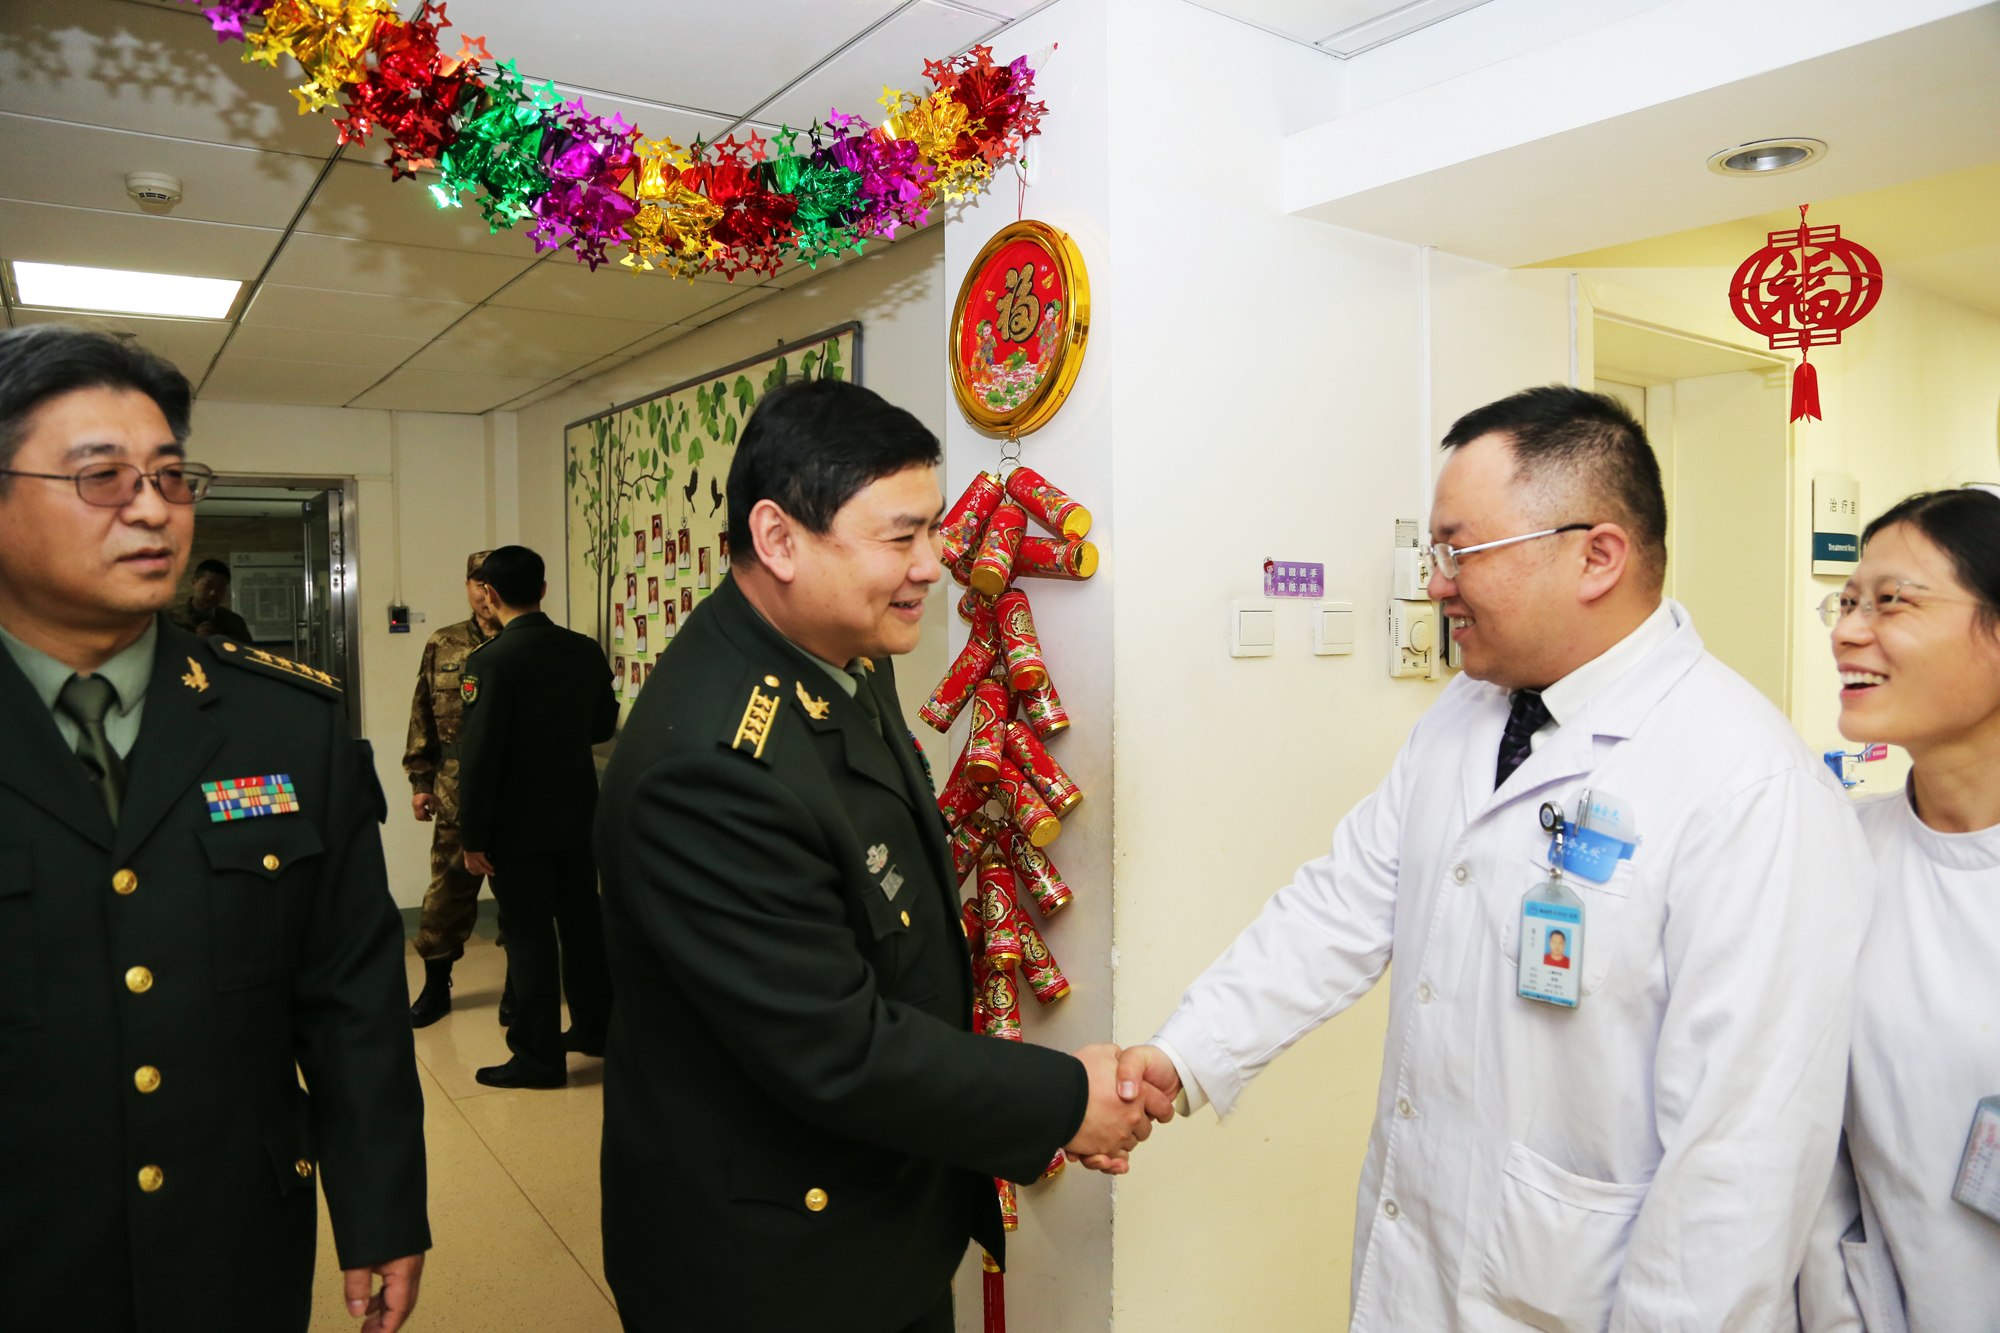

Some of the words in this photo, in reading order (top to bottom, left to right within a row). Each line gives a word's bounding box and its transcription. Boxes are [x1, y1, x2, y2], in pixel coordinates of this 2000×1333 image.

[995, 262, 1040, 343] 福
[1760, 246, 1842, 329] 福
[983, 889, 1004, 921] 福
[1021, 929, 1049, 963] 福
[986, 977, 1014, 1009] 福
